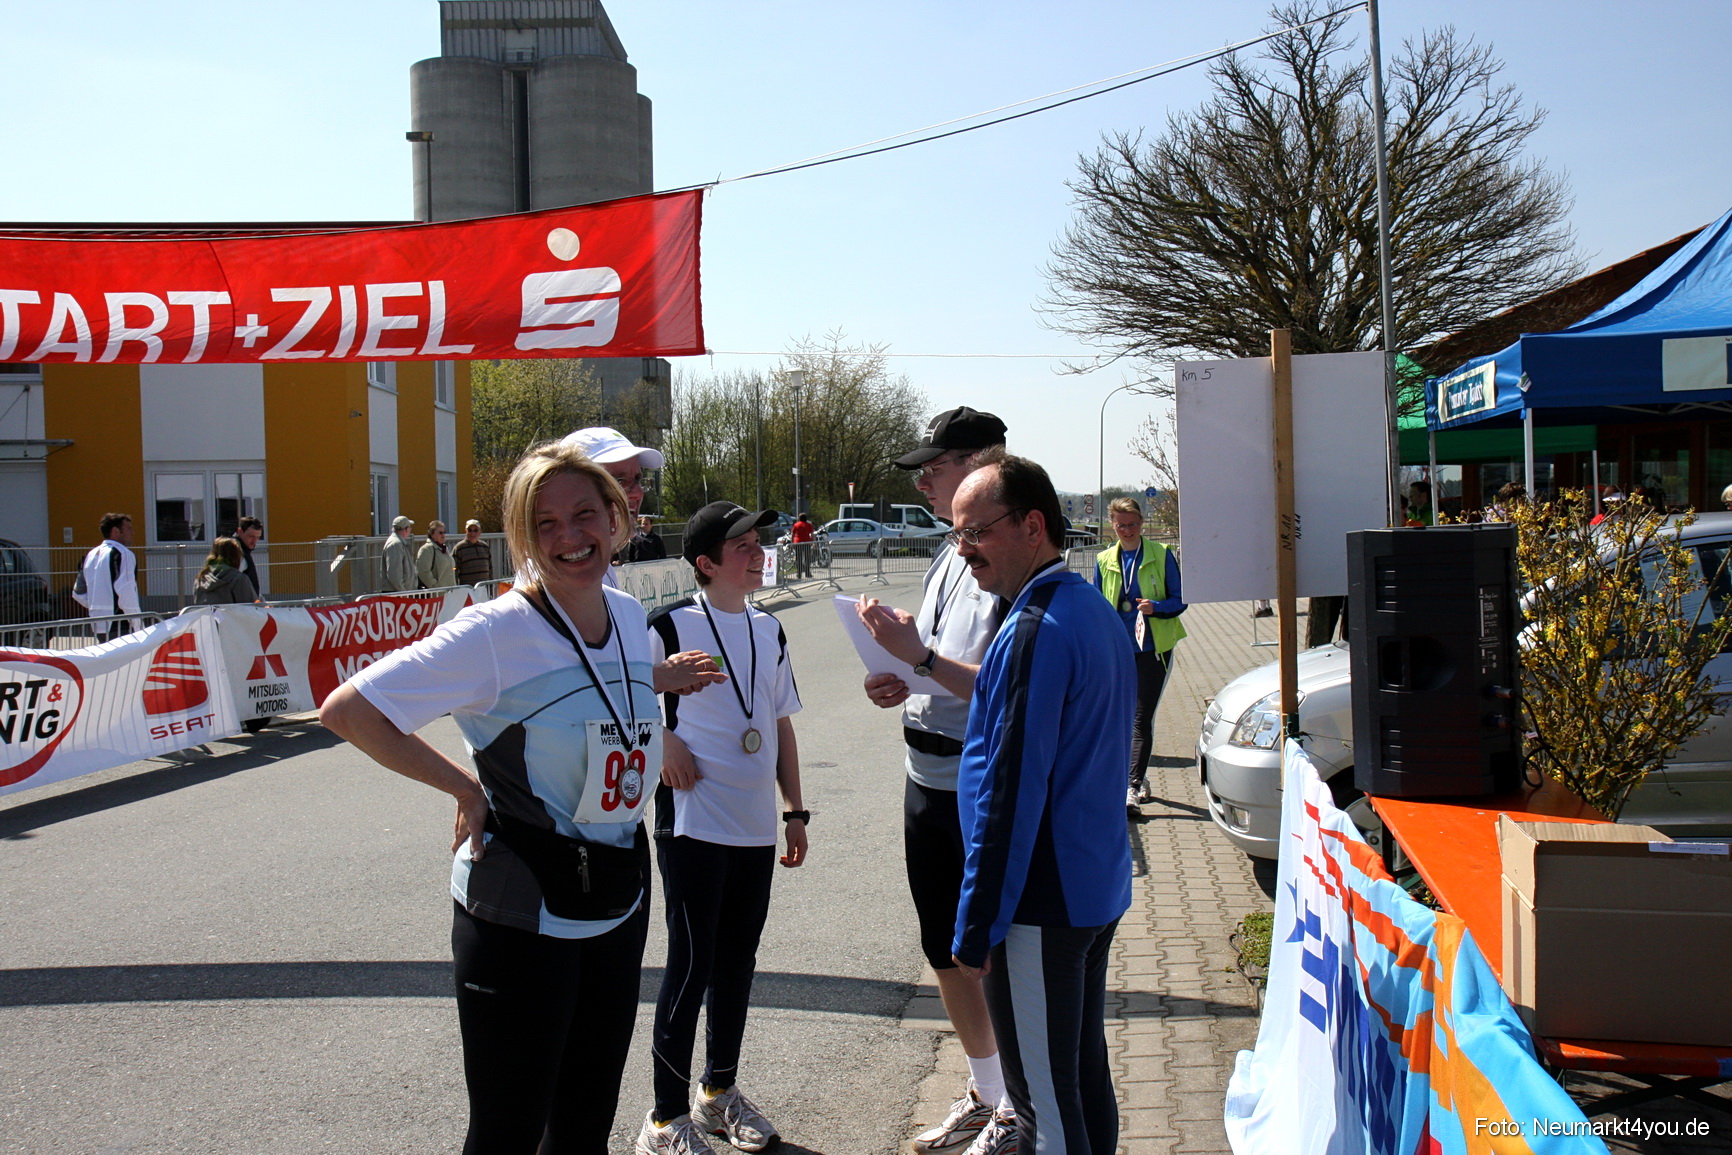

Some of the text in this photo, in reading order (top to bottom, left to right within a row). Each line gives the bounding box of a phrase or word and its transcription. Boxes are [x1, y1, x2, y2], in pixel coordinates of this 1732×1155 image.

[1201, 367, 1215, 380] 5
[248, 682, 291, 699] MITSUBISHI
[256, 697, 288, 714] MOTORS
[150, 713, 216, 740] SEAT
